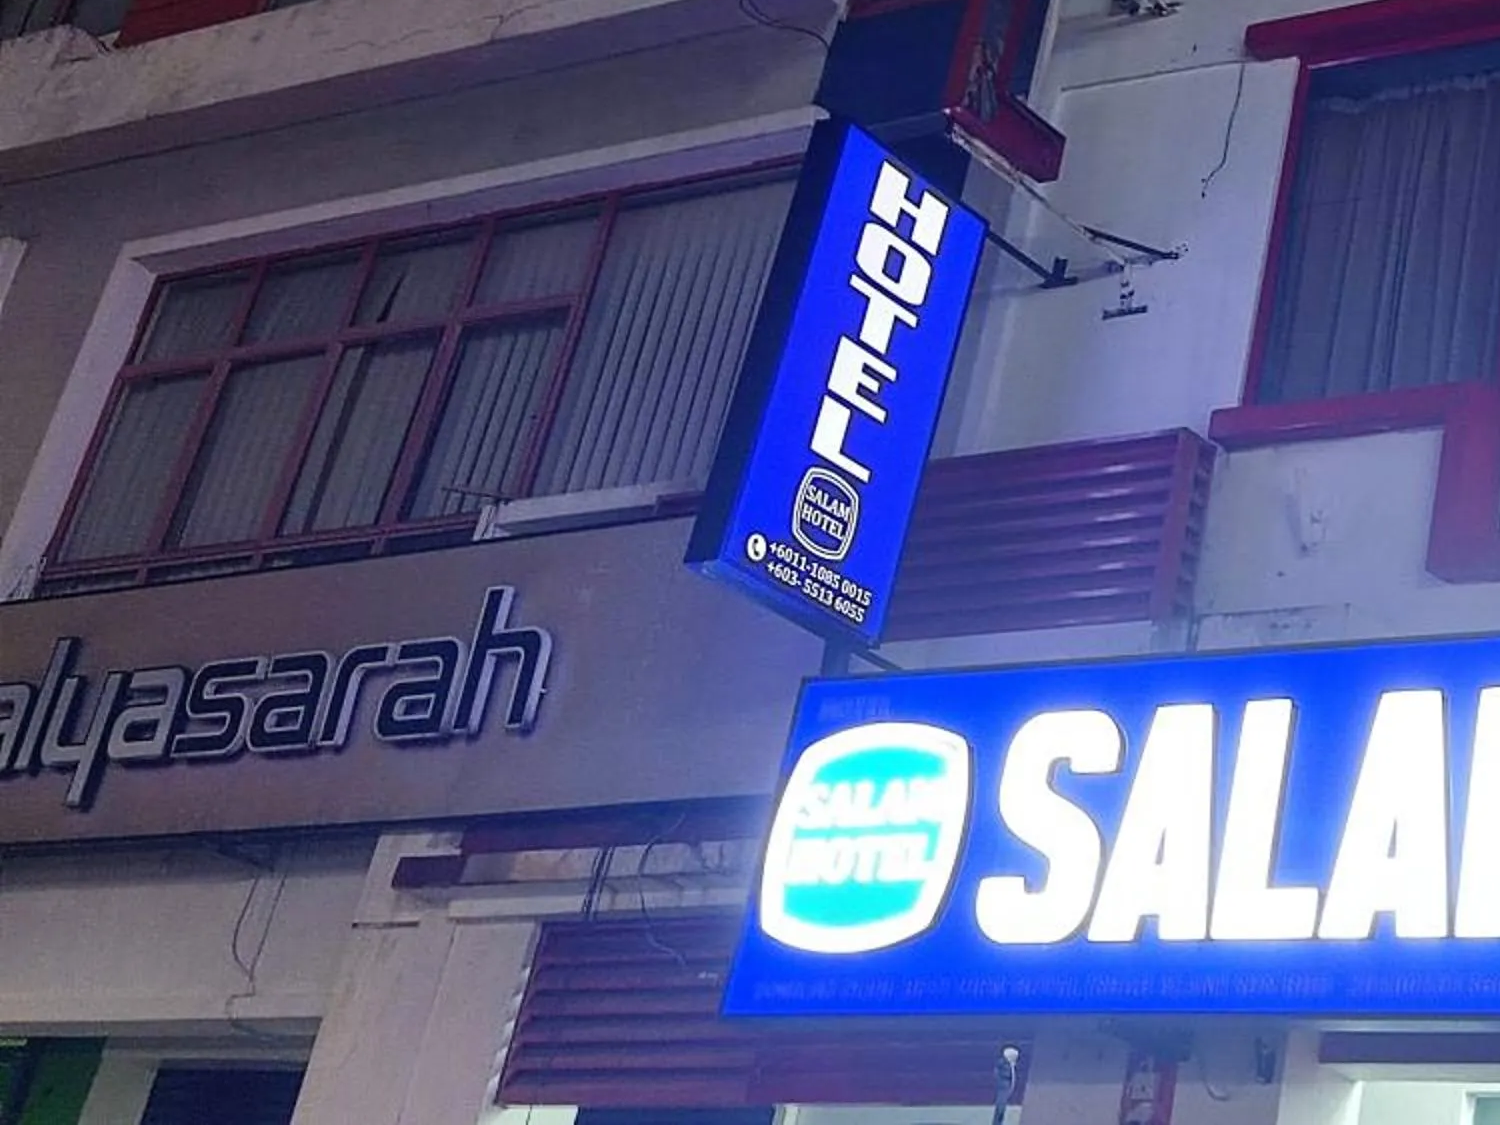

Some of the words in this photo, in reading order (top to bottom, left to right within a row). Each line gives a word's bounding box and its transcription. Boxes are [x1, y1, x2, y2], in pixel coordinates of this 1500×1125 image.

[810, 160, 949, 484] HOTEL
[801, 502, 846, 541] HOTEL
[805, 484, 851, 521] SALAM
[802, 579, 835, 606] 5513
[834, 596, 866, 623] 6055
[841, 575, 873, 607] 0015
